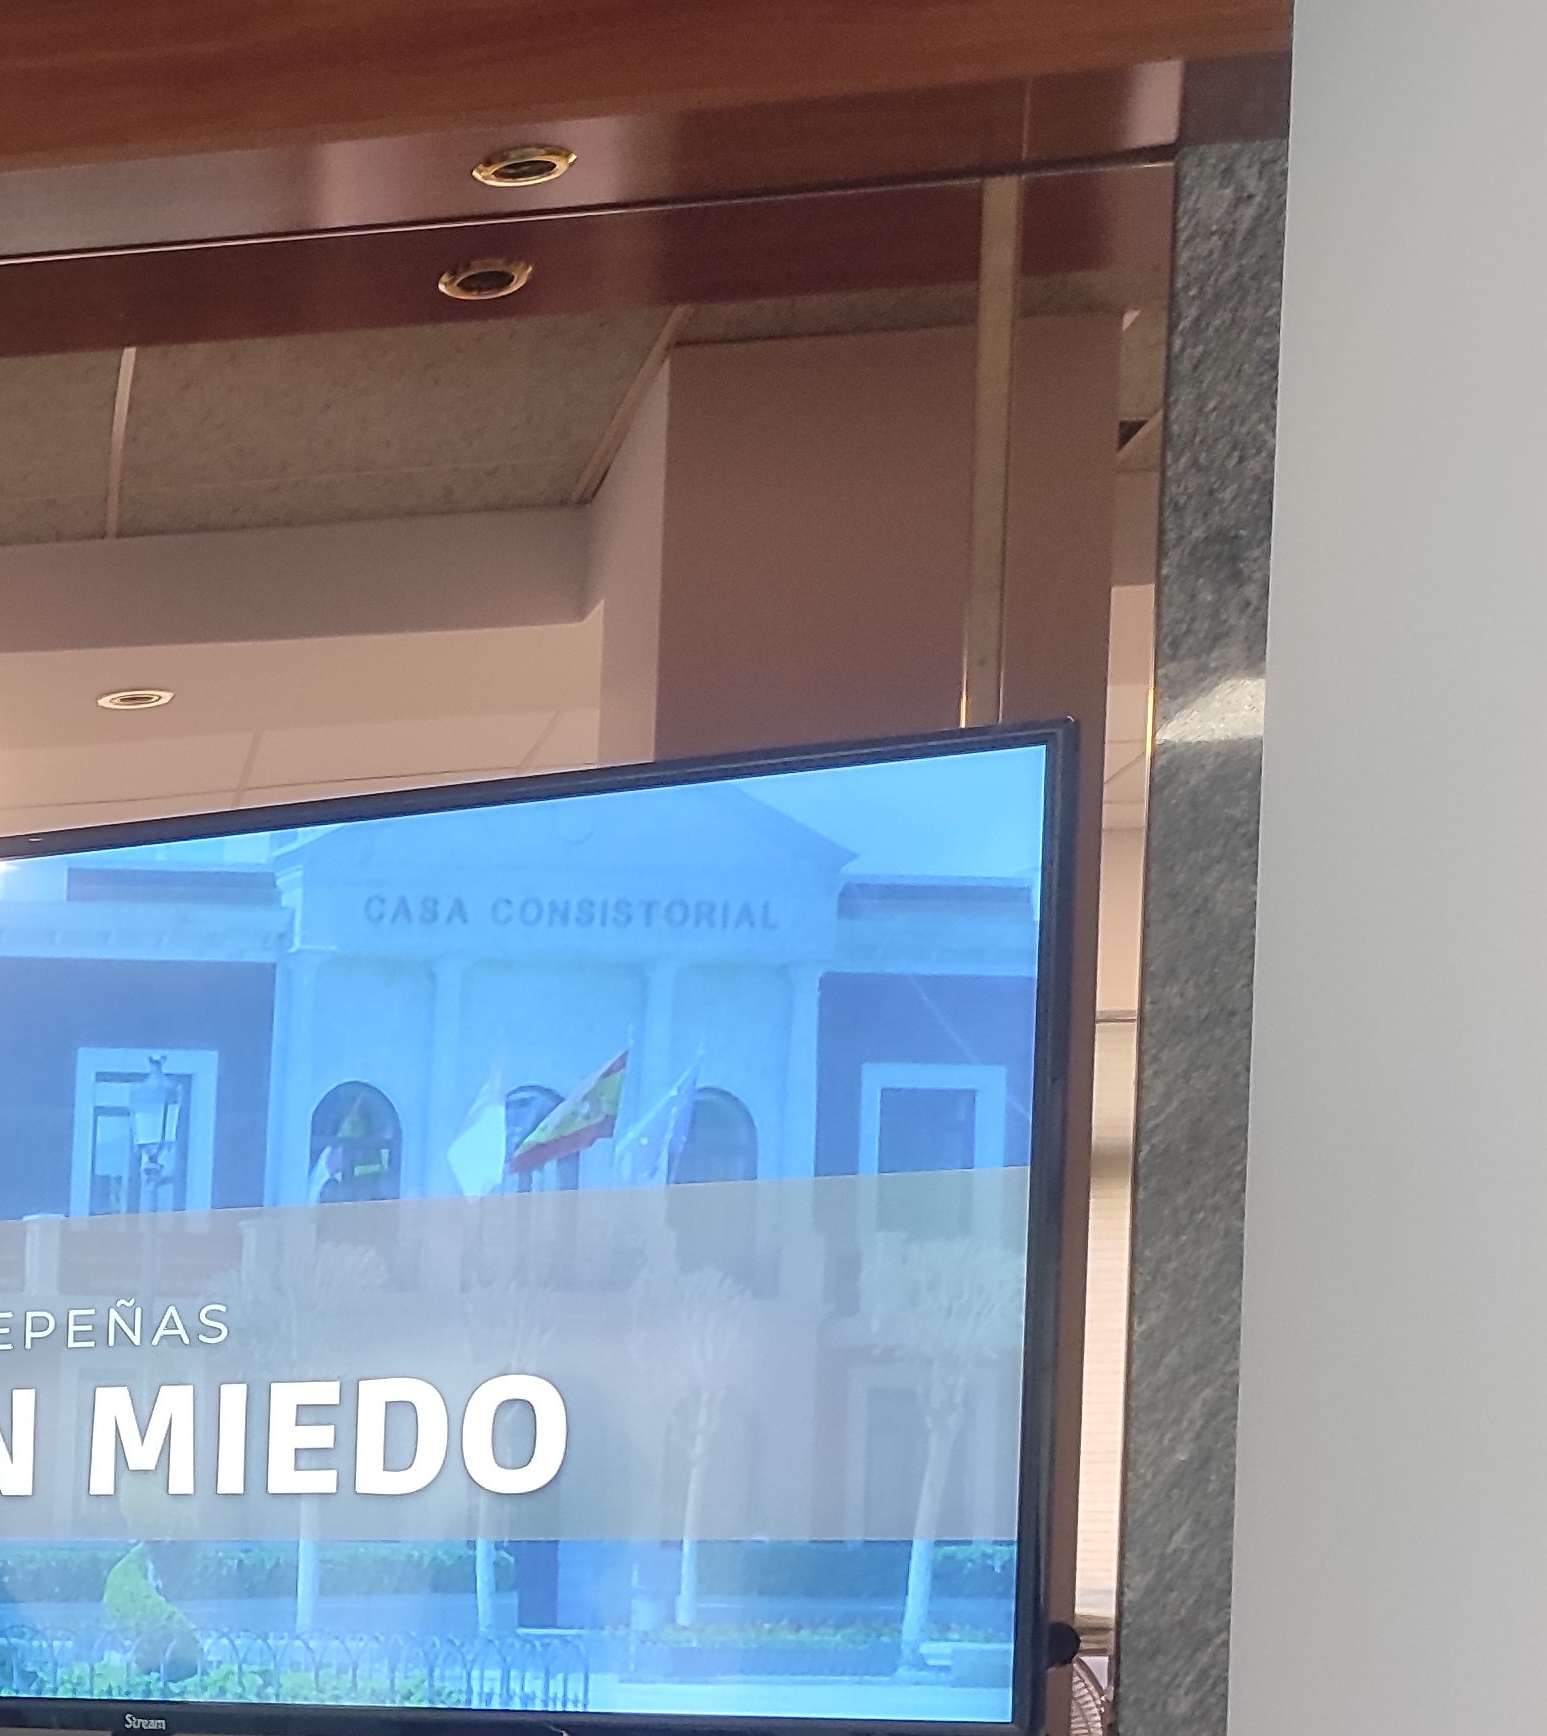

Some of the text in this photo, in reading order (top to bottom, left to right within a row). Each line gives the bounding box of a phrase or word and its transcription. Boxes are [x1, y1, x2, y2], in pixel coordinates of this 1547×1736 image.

[363, 893, 779, 931] CASA CONSISTORIAL
[88, 1373, 568, 1496] MIEDO
[124, 1713, 167, 1731] Stream
